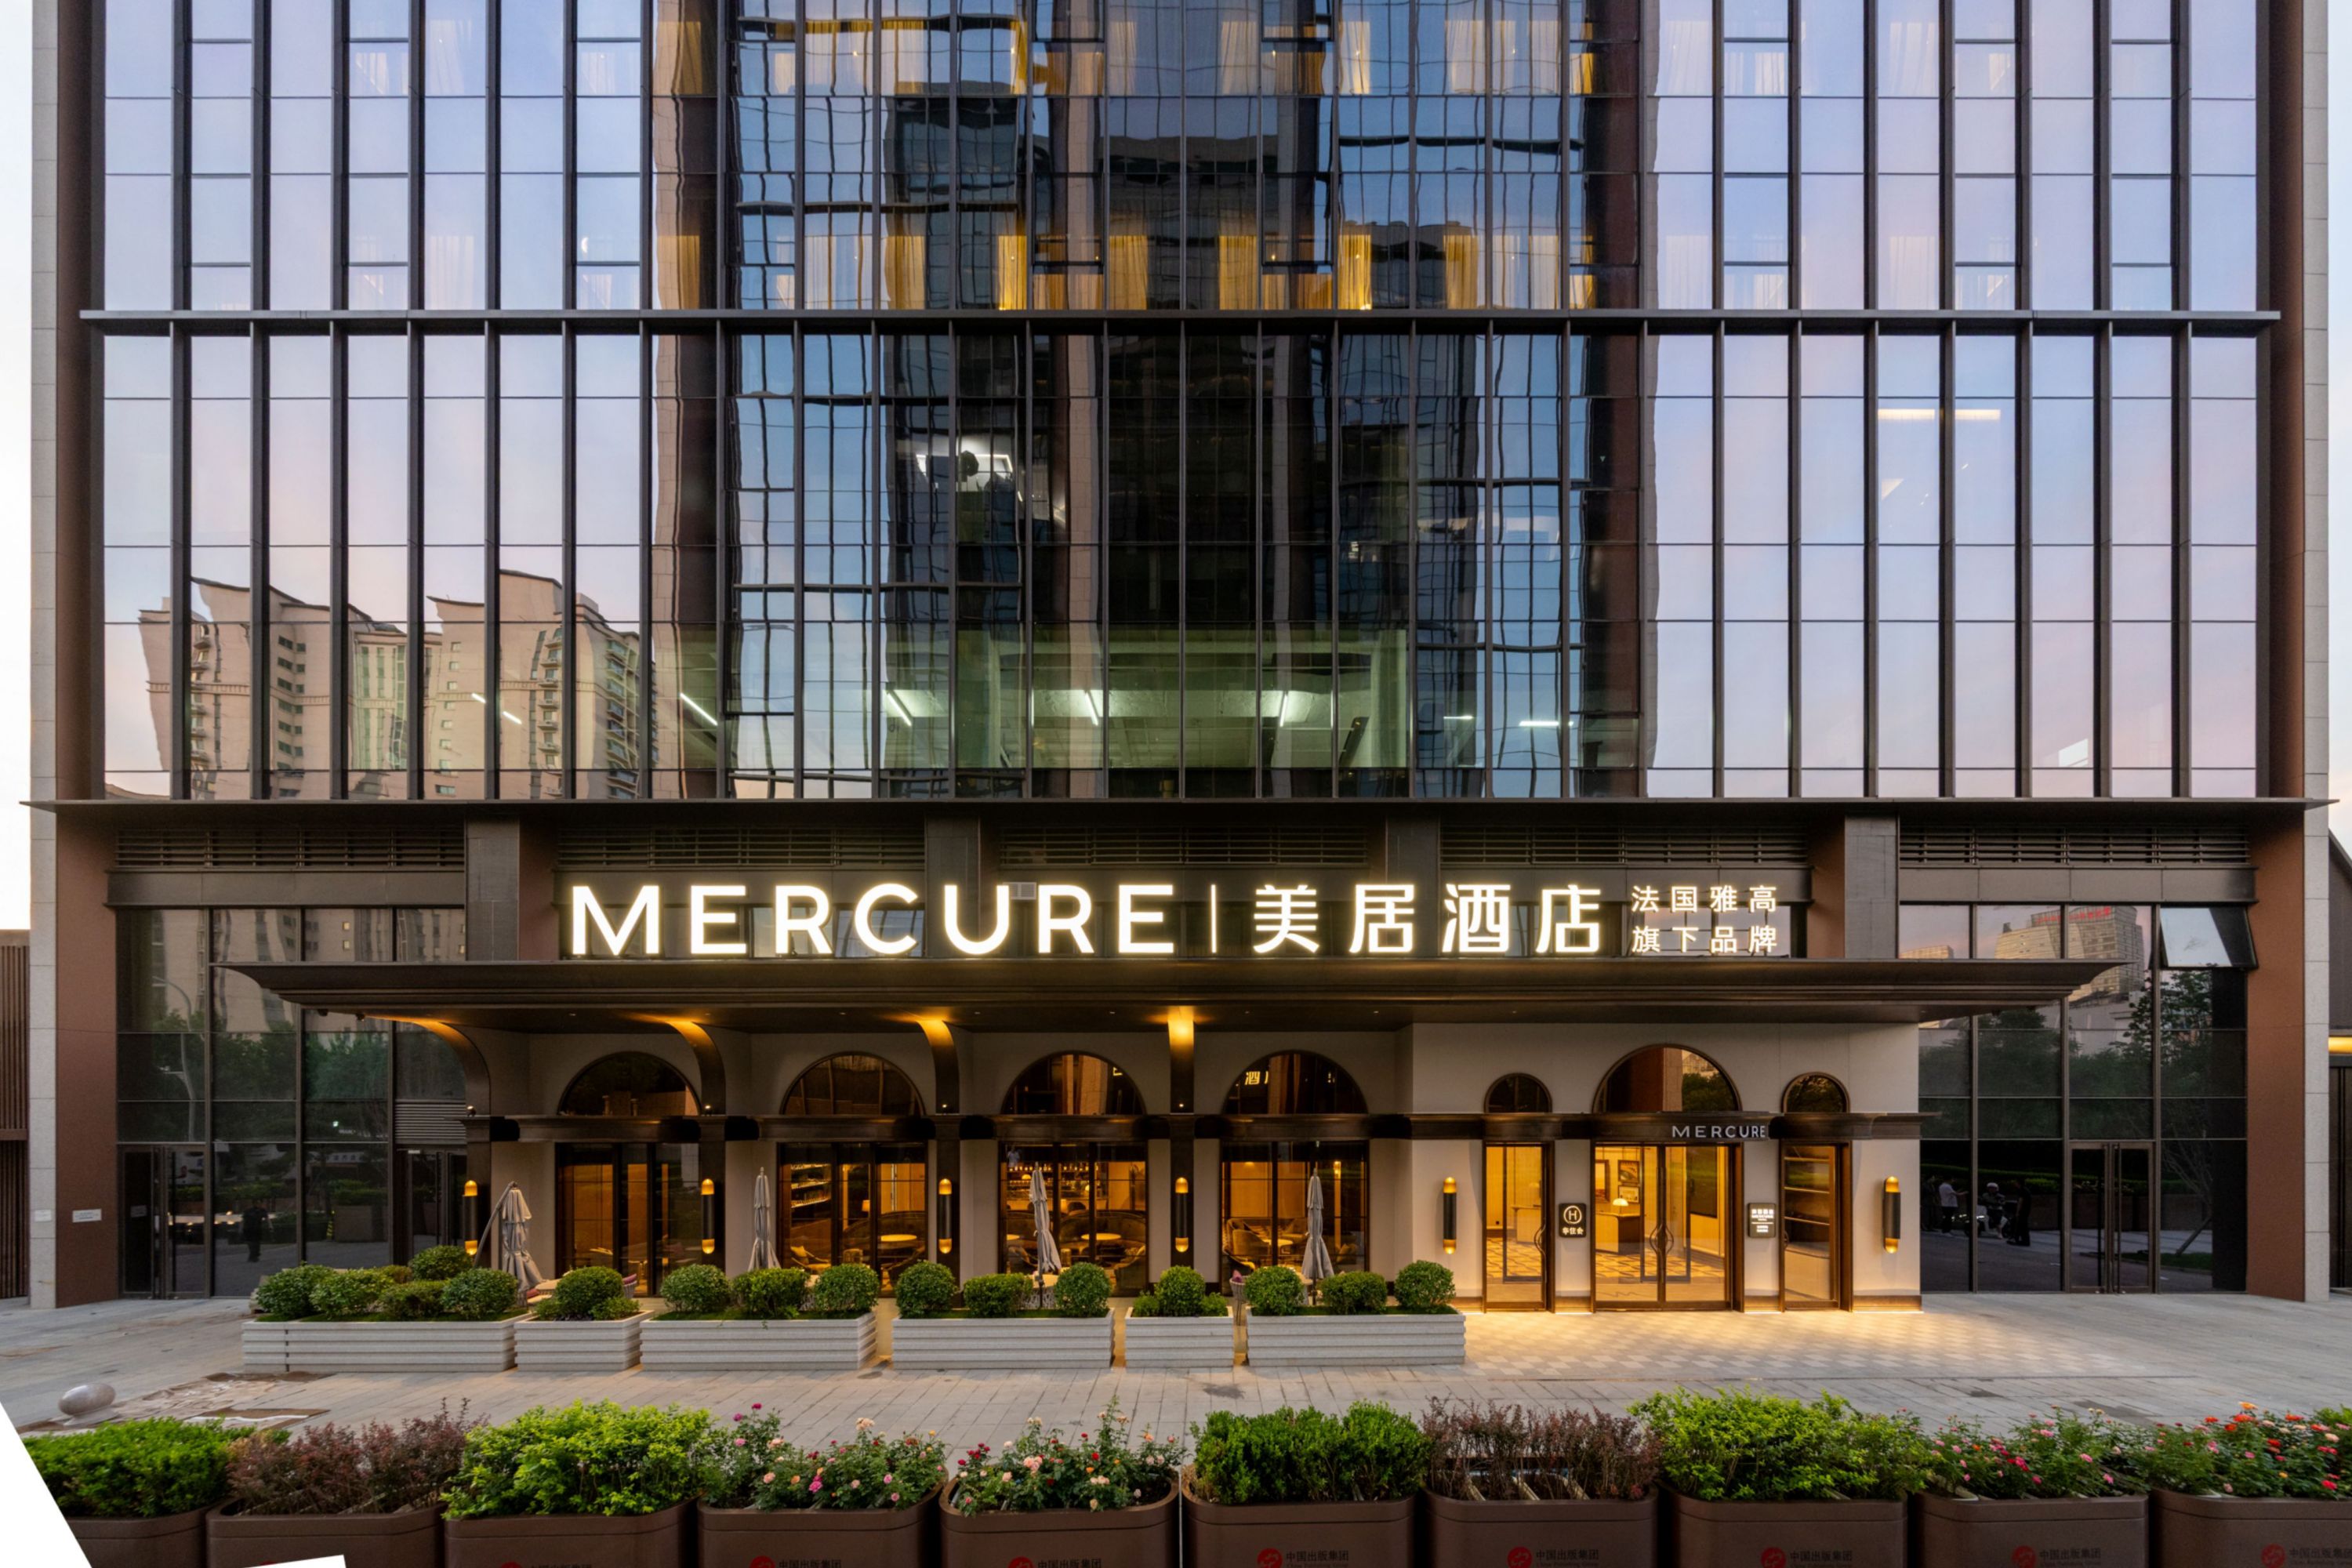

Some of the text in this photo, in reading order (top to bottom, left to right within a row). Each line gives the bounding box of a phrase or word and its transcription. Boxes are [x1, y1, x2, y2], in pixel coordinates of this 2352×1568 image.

[1631, 884, 1777, 913] 法国雅高
[572, 883, 1602, 956] MERCURE 美居酒店
[1632, 925, 1777, 953] 旗下品牌
[1671, 1125, 1766, 1138] MERCURE
[1287, 1551, 1348, 1562] 中国出版集团
[1536, 1549, 1599, 1560] 中国出版集团
